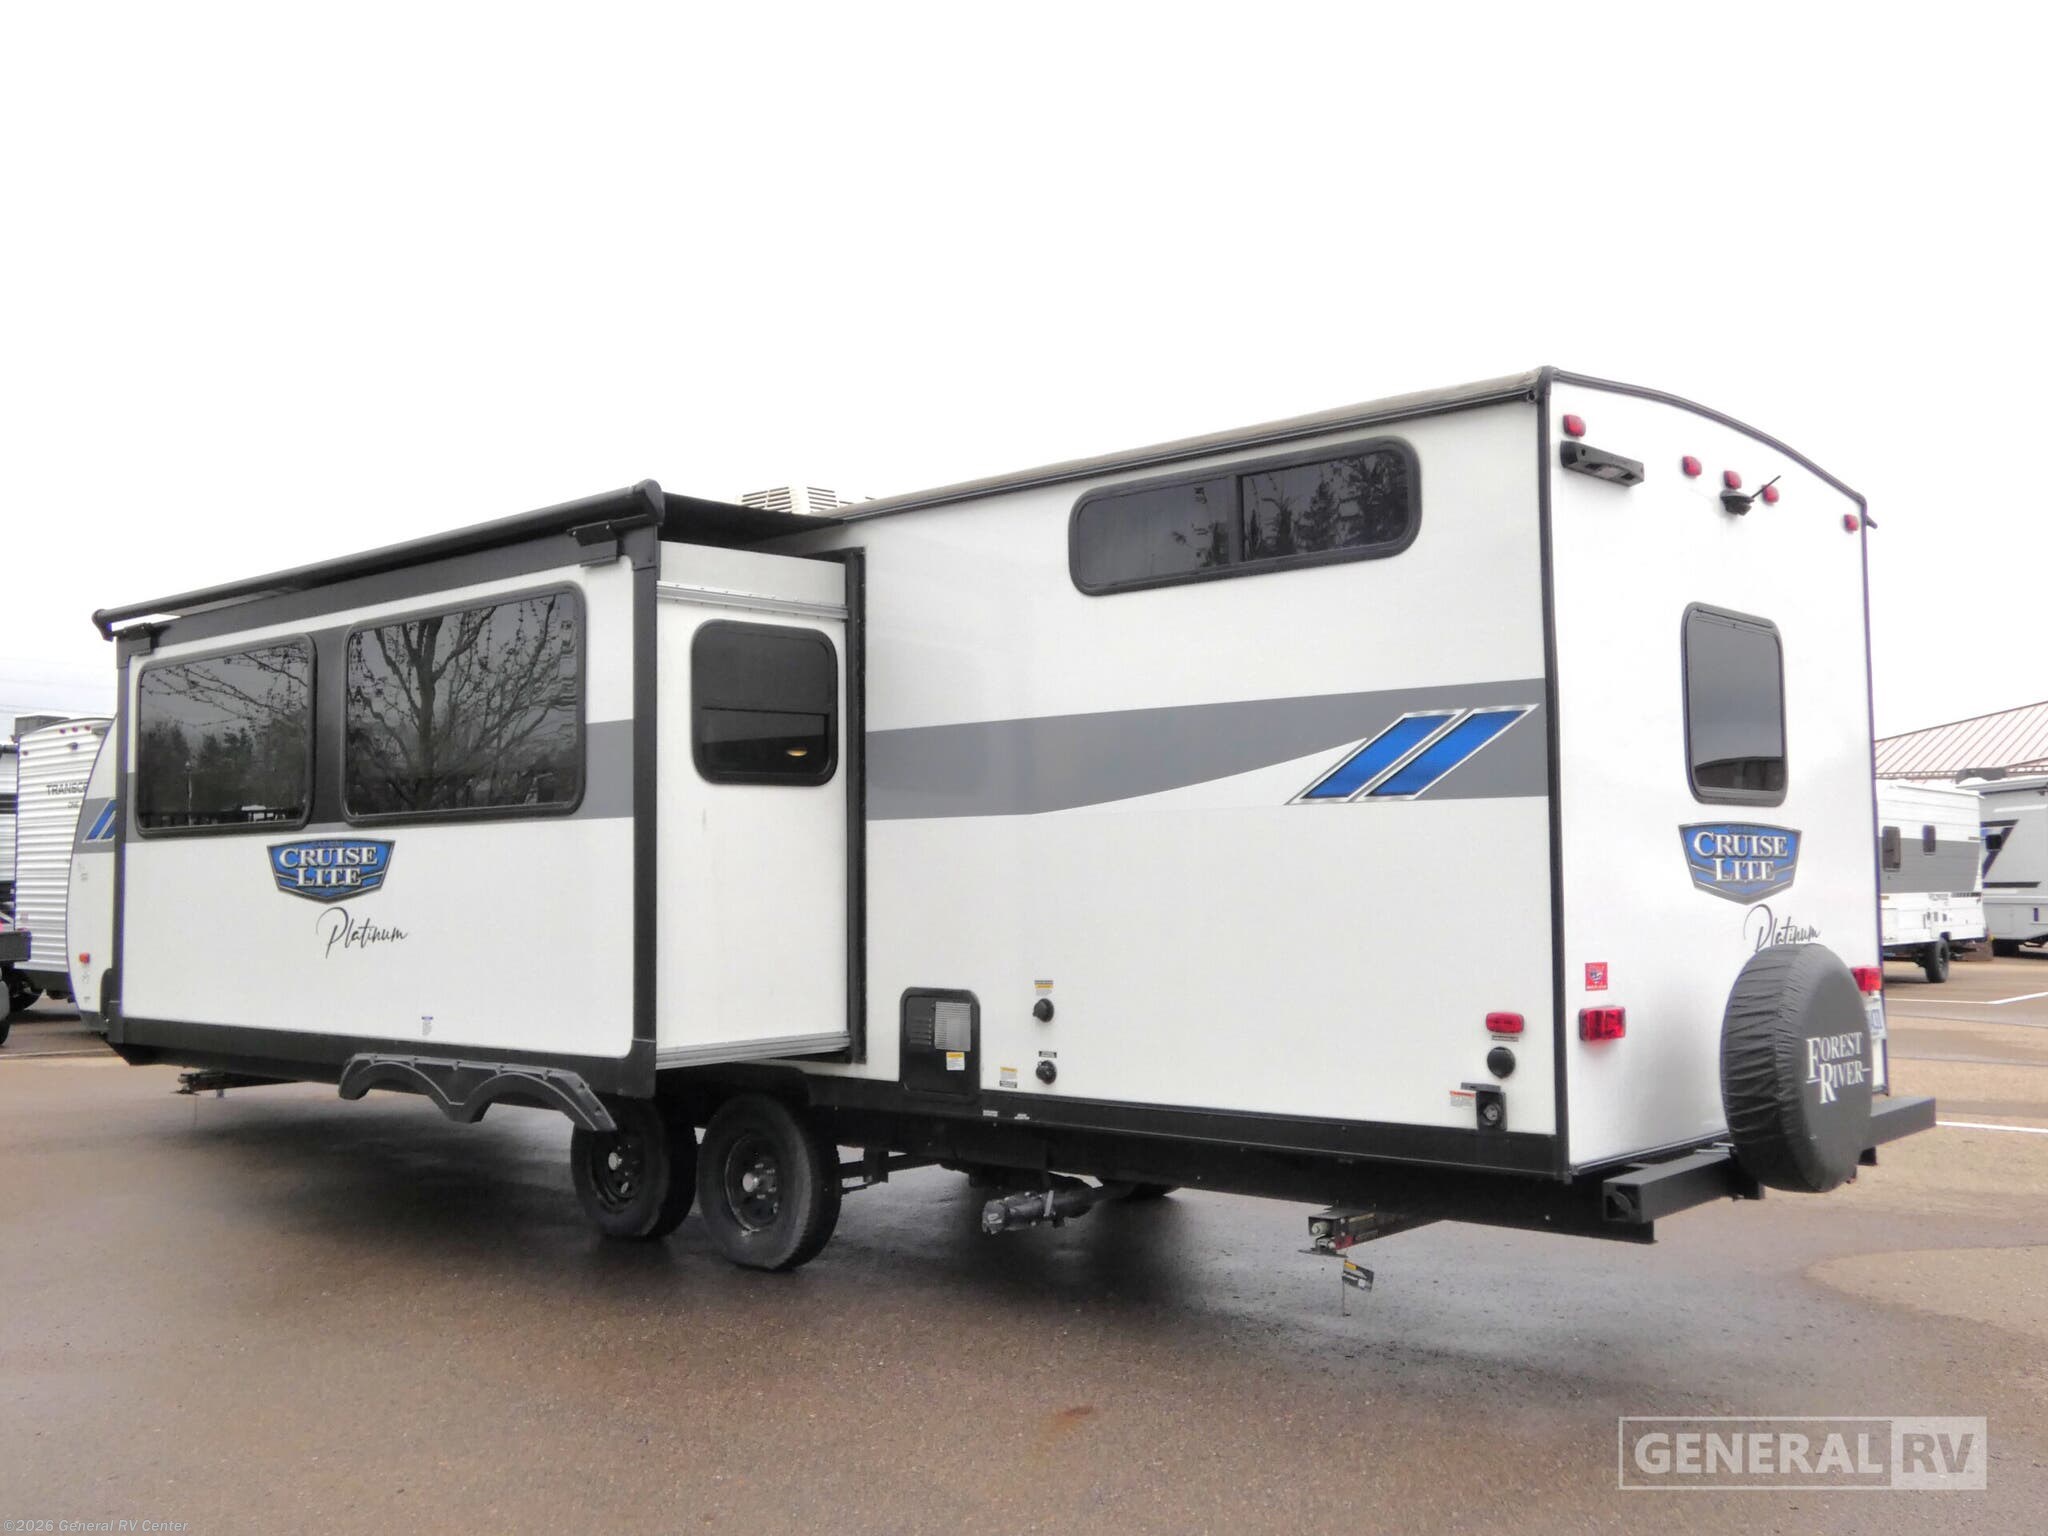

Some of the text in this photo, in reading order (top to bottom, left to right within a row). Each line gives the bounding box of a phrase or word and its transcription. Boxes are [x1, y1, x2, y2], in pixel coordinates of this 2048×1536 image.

[279, 846, 378, 868] CRUISE
[1693, 831, 1788, 857] CRUISE
[296, 867, 361, 888] LITE
[1713, 857, 1775, 882] LITE
[316, 906, 408, 959] Platinum
[1744, 903, 1821, 951] Platinum
[1806, 1031, 1863, 1080] FOREST
[1820, 1060, 1865, 1104] RIVER
